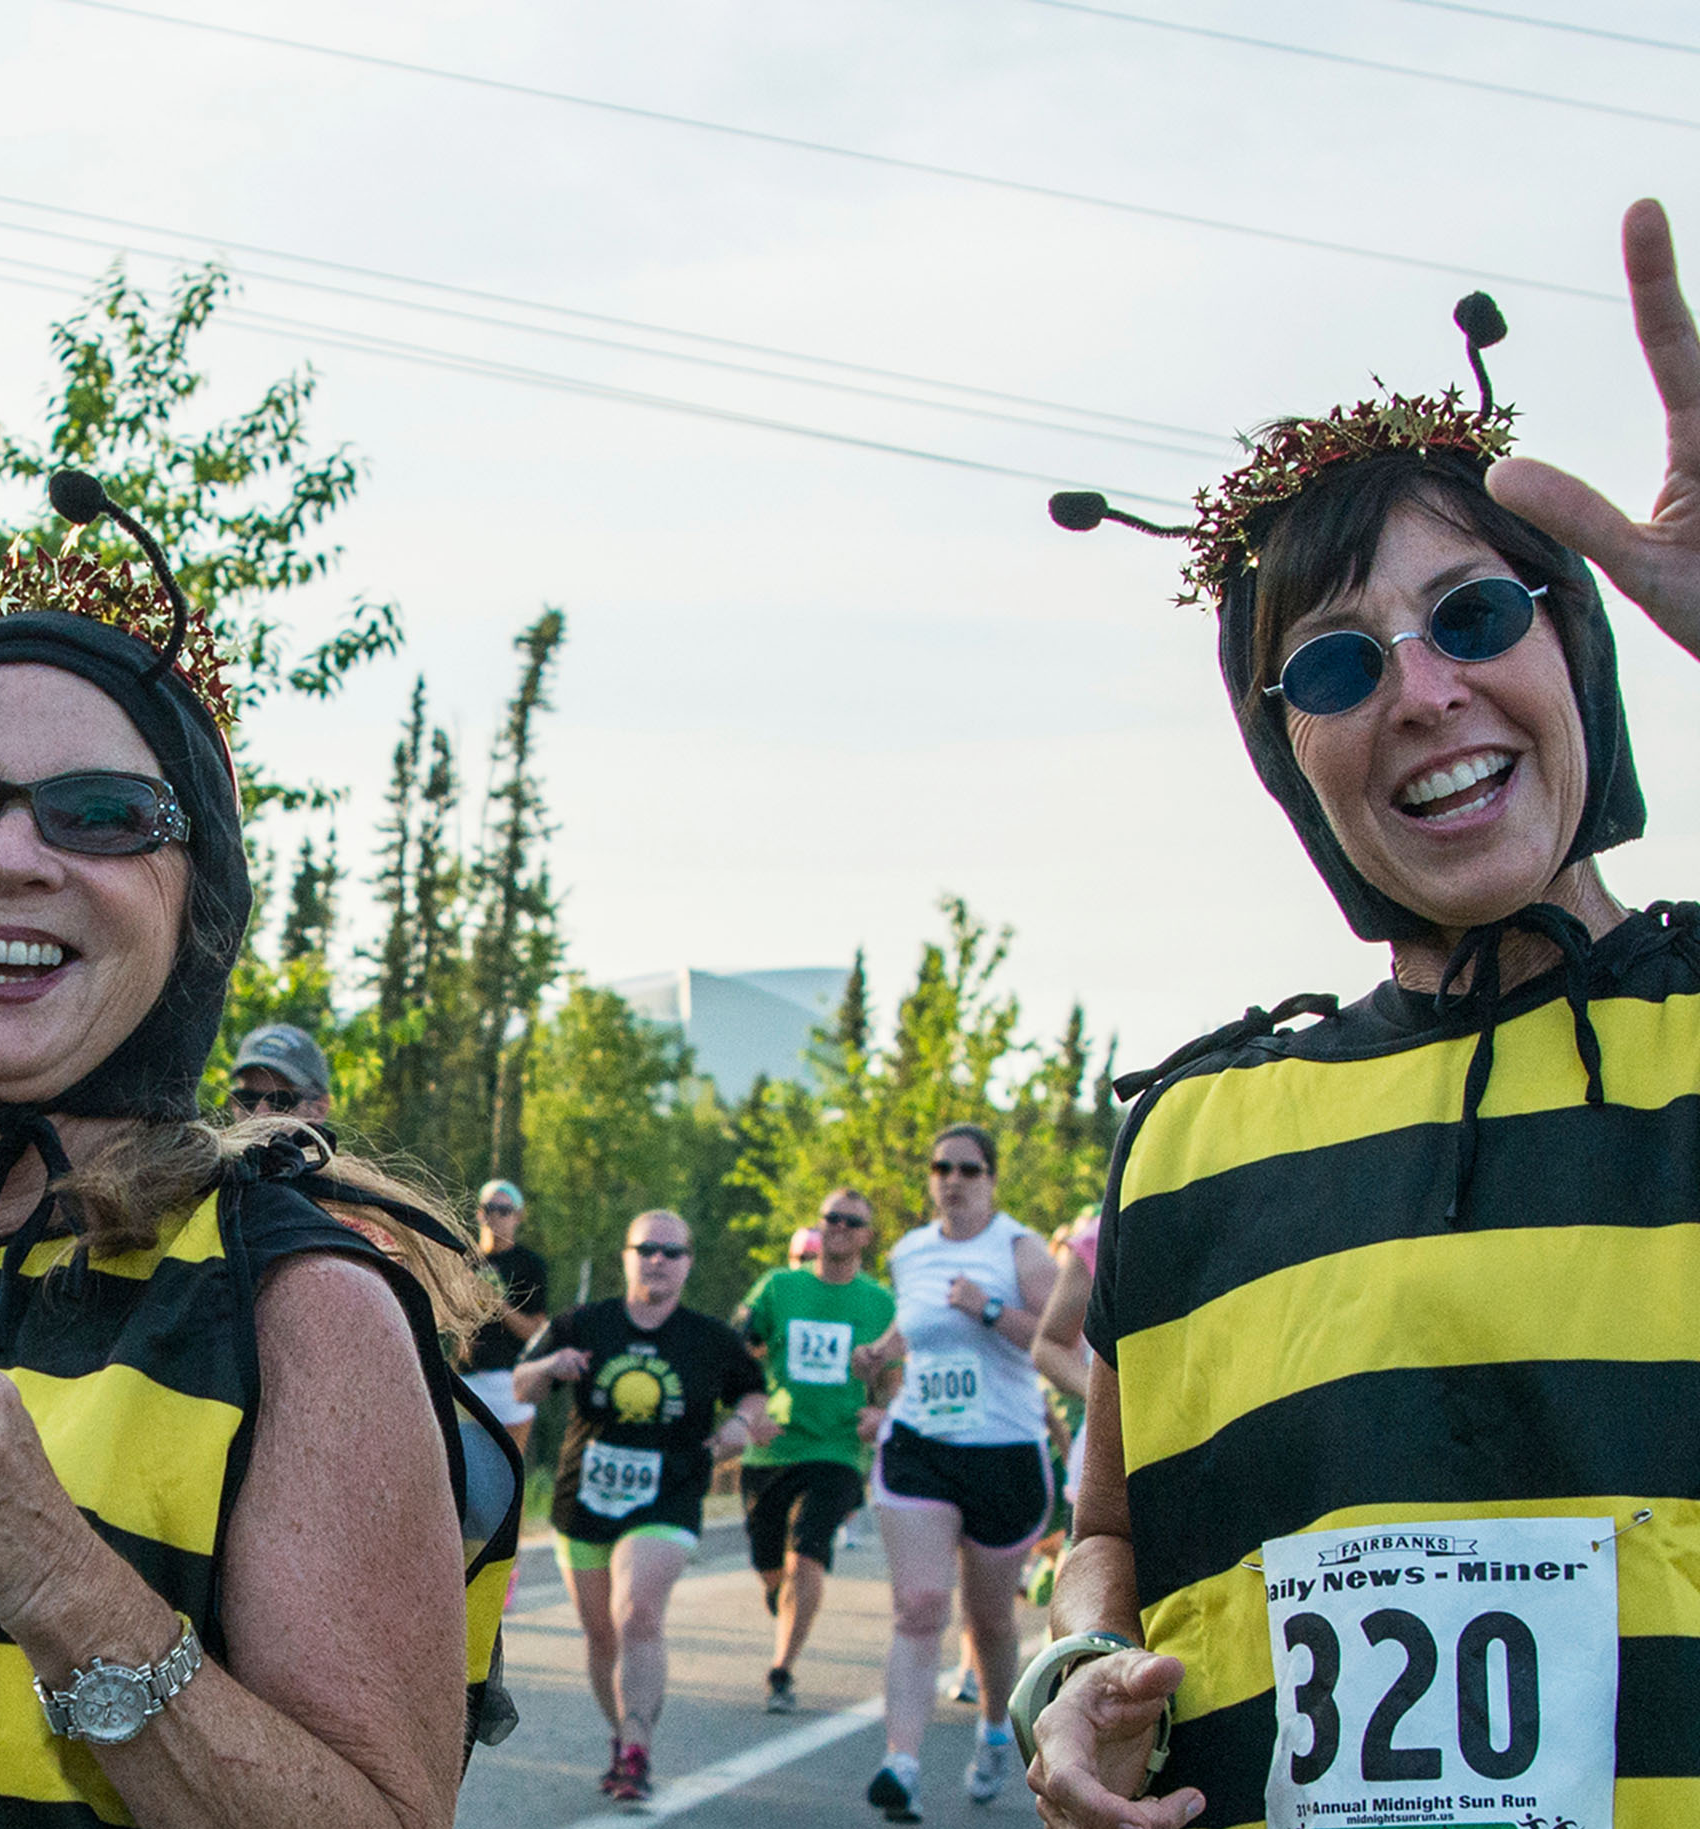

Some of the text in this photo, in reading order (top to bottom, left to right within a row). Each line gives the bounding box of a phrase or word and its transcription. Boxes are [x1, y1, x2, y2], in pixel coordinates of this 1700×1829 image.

[919, 1368, 977, 1403] 3000
[587, 1456, 653, 1490] 2999
[1341, 1536, 1448, 1559] FAIRBANKS
[1324, 1566, 1426, 1593] News
[1458, 1562, 1588, 1584] Miner
[1283, 1608, 1540, 1786] 320
[1313, 1800, 1367, 1815] Annual
[1373, 1796, 1453, 1814] Midnight
[1459, 1795, 1495, 1809] Sun
[1502, 1794, 1537, 1808] Run
[1346, 1813, 1455, 1825] midnightsunrun.us
